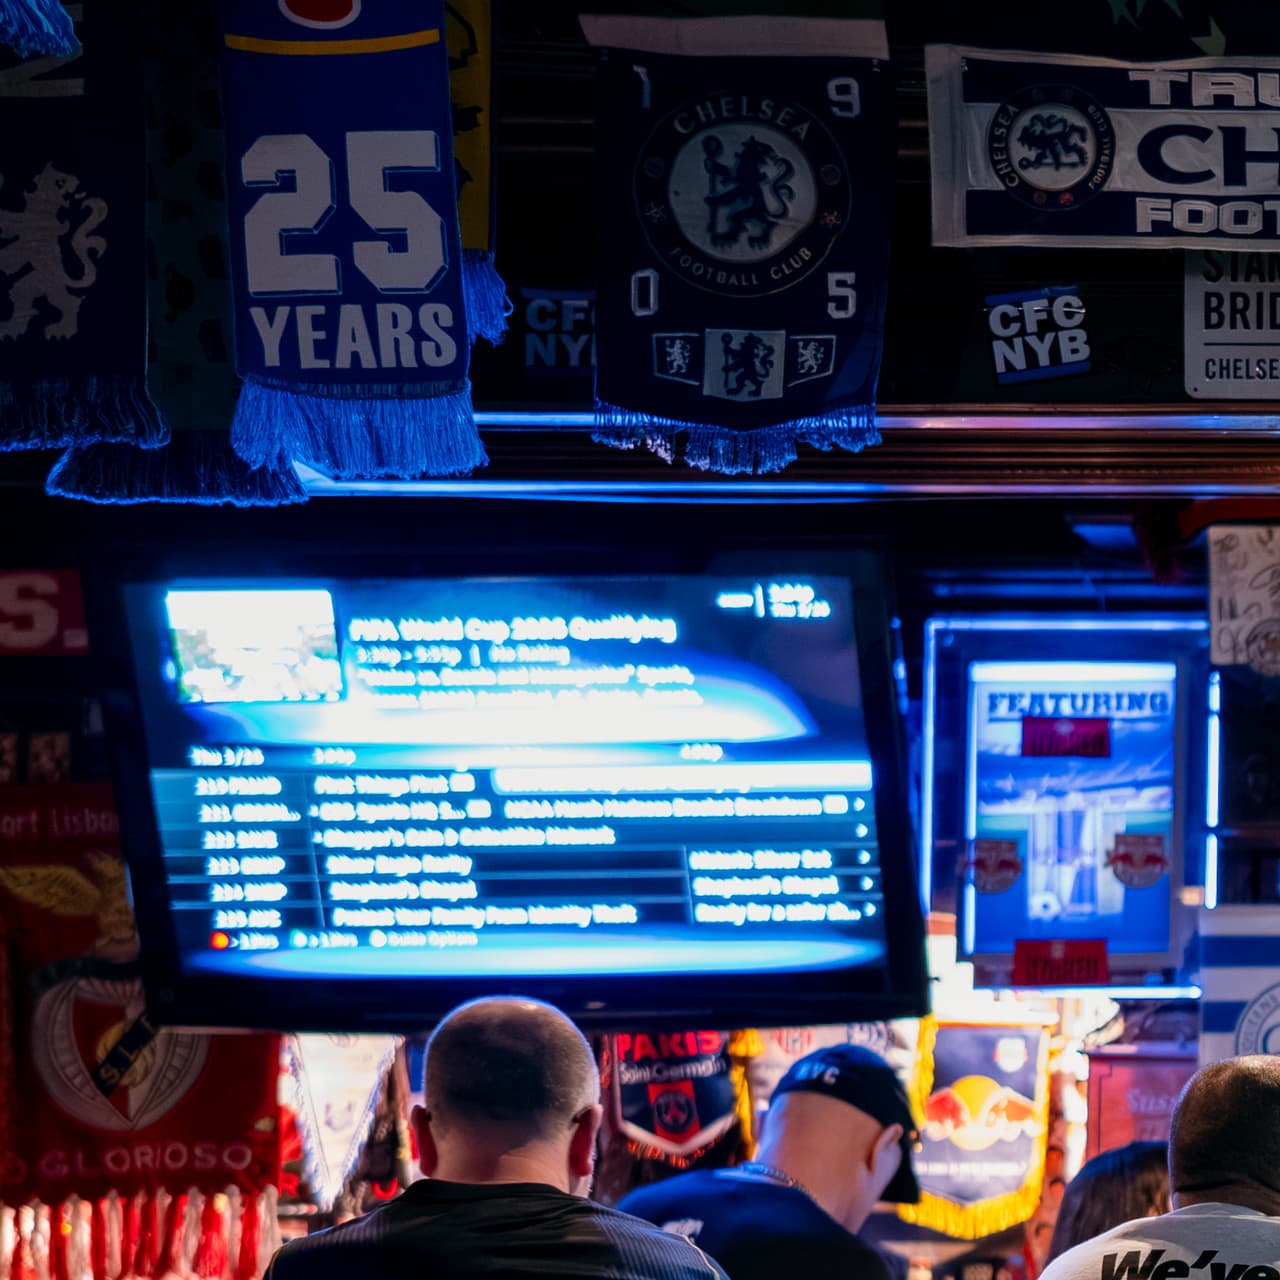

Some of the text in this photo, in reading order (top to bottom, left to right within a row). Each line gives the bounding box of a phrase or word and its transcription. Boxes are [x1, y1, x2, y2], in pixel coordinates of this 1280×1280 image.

[671, 96, 811, 142] CHELSEA
[826, 77, 861, 119] 9
[991, 103, 1021, 188] CHELSEA
[241, 130, 448, 297] 25
[768, 245, 814, 281] CLUB
[826, 272, 858, 320] 5
[987, 295, 1086, 338] CFC
[250, 303, 458, 369] YEARS
[992, 328, 1092, 374] NYB
[988, 692, 1169, 714] FEATURING
[40, 1140, 254, 1179] GLORIOSO
